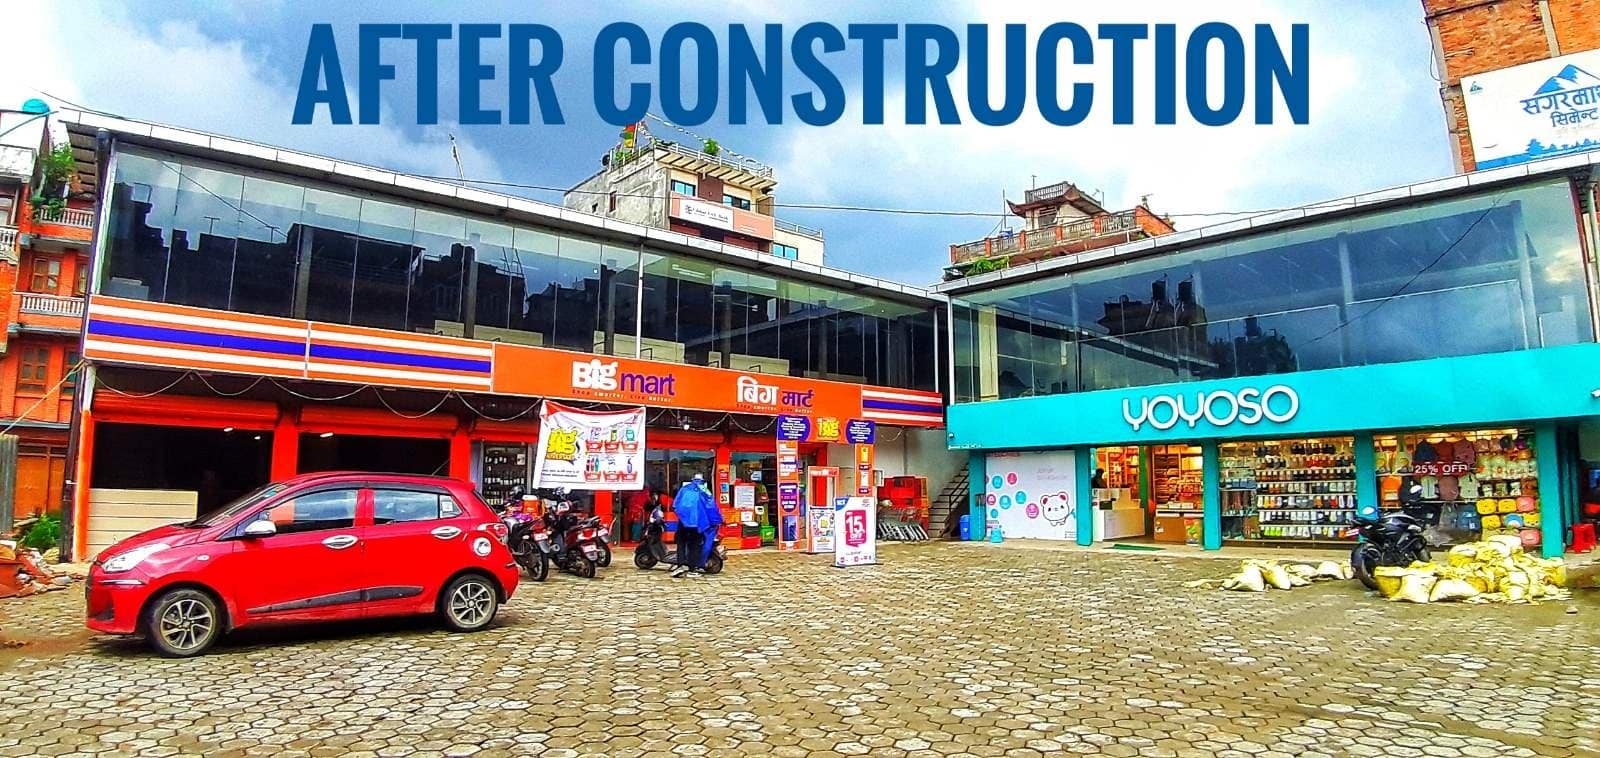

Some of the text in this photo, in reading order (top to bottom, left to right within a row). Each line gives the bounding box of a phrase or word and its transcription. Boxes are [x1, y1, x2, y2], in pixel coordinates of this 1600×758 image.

[1550, 107, 1599, 127] सिमेन्ट
[572, 359, 676, 396] Big mart
[736, 375, 814, 408] बिग मार्ट
[1122, 385, 1299, 432] YOYOSO
[1415, 465, 1438, 474] 25%
